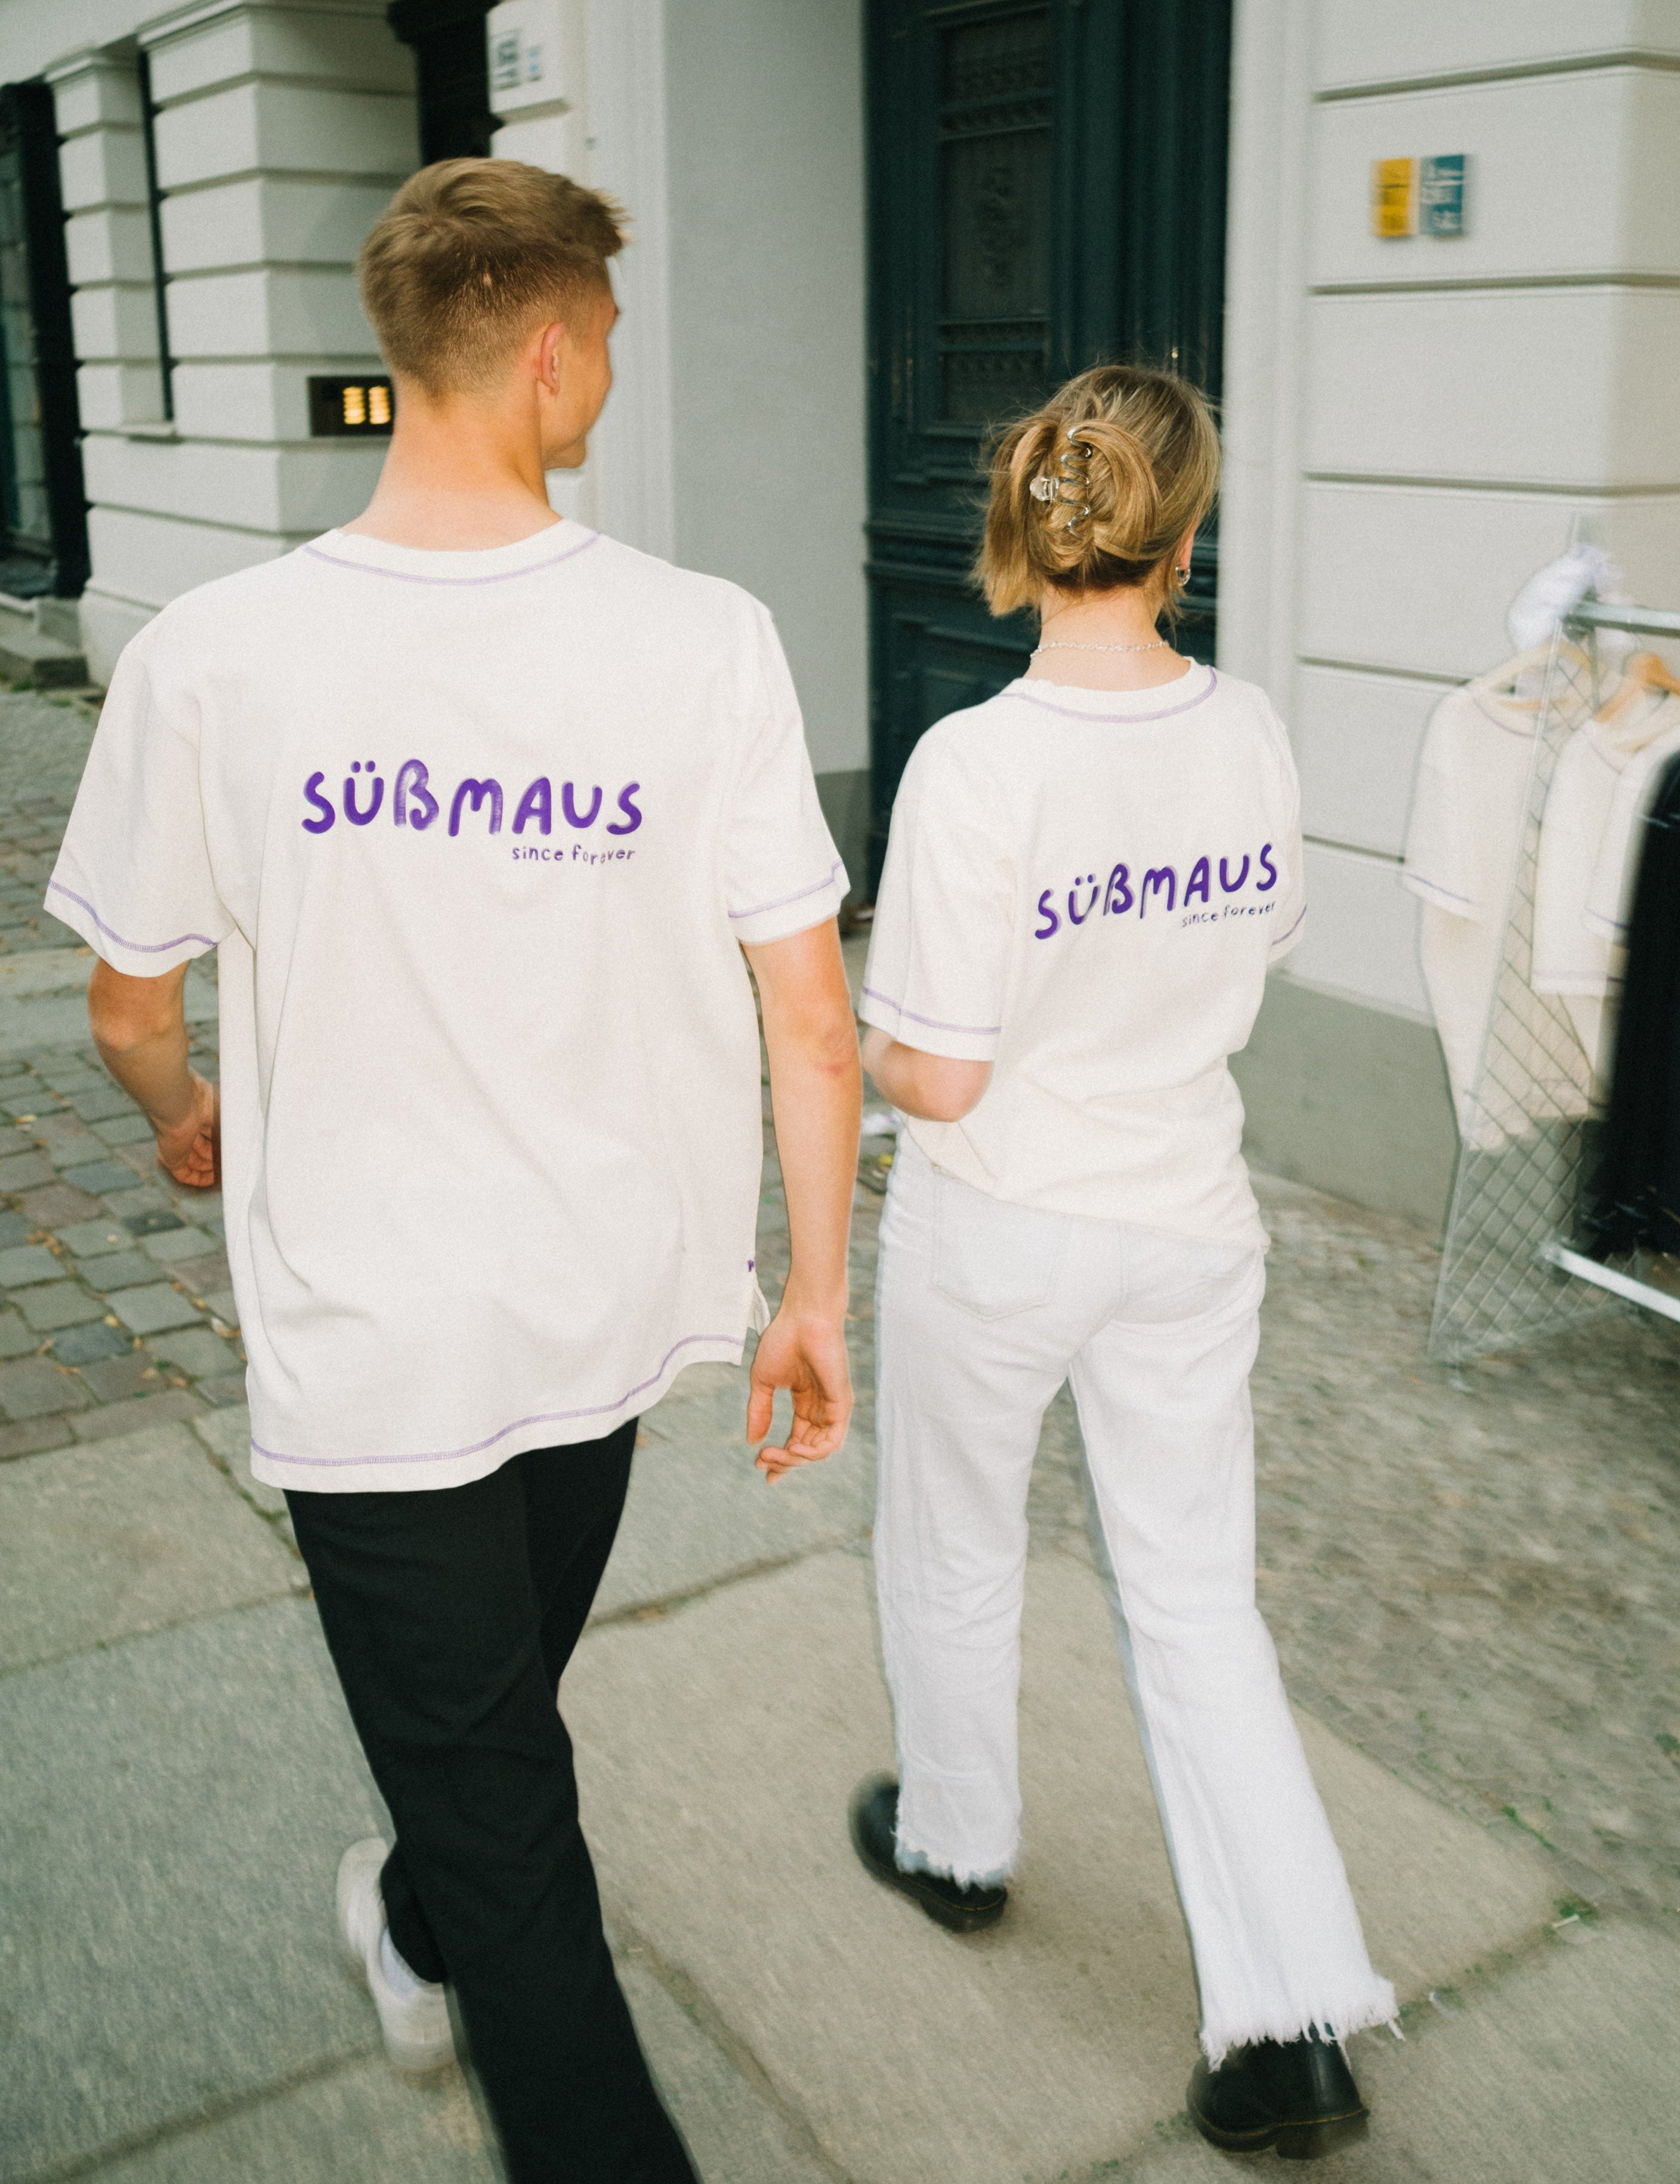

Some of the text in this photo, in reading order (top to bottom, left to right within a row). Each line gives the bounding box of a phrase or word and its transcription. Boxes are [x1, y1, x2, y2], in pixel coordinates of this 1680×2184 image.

[512, 844, 636, 865] since forever
[1182, 901, 1276, 927] since forever
